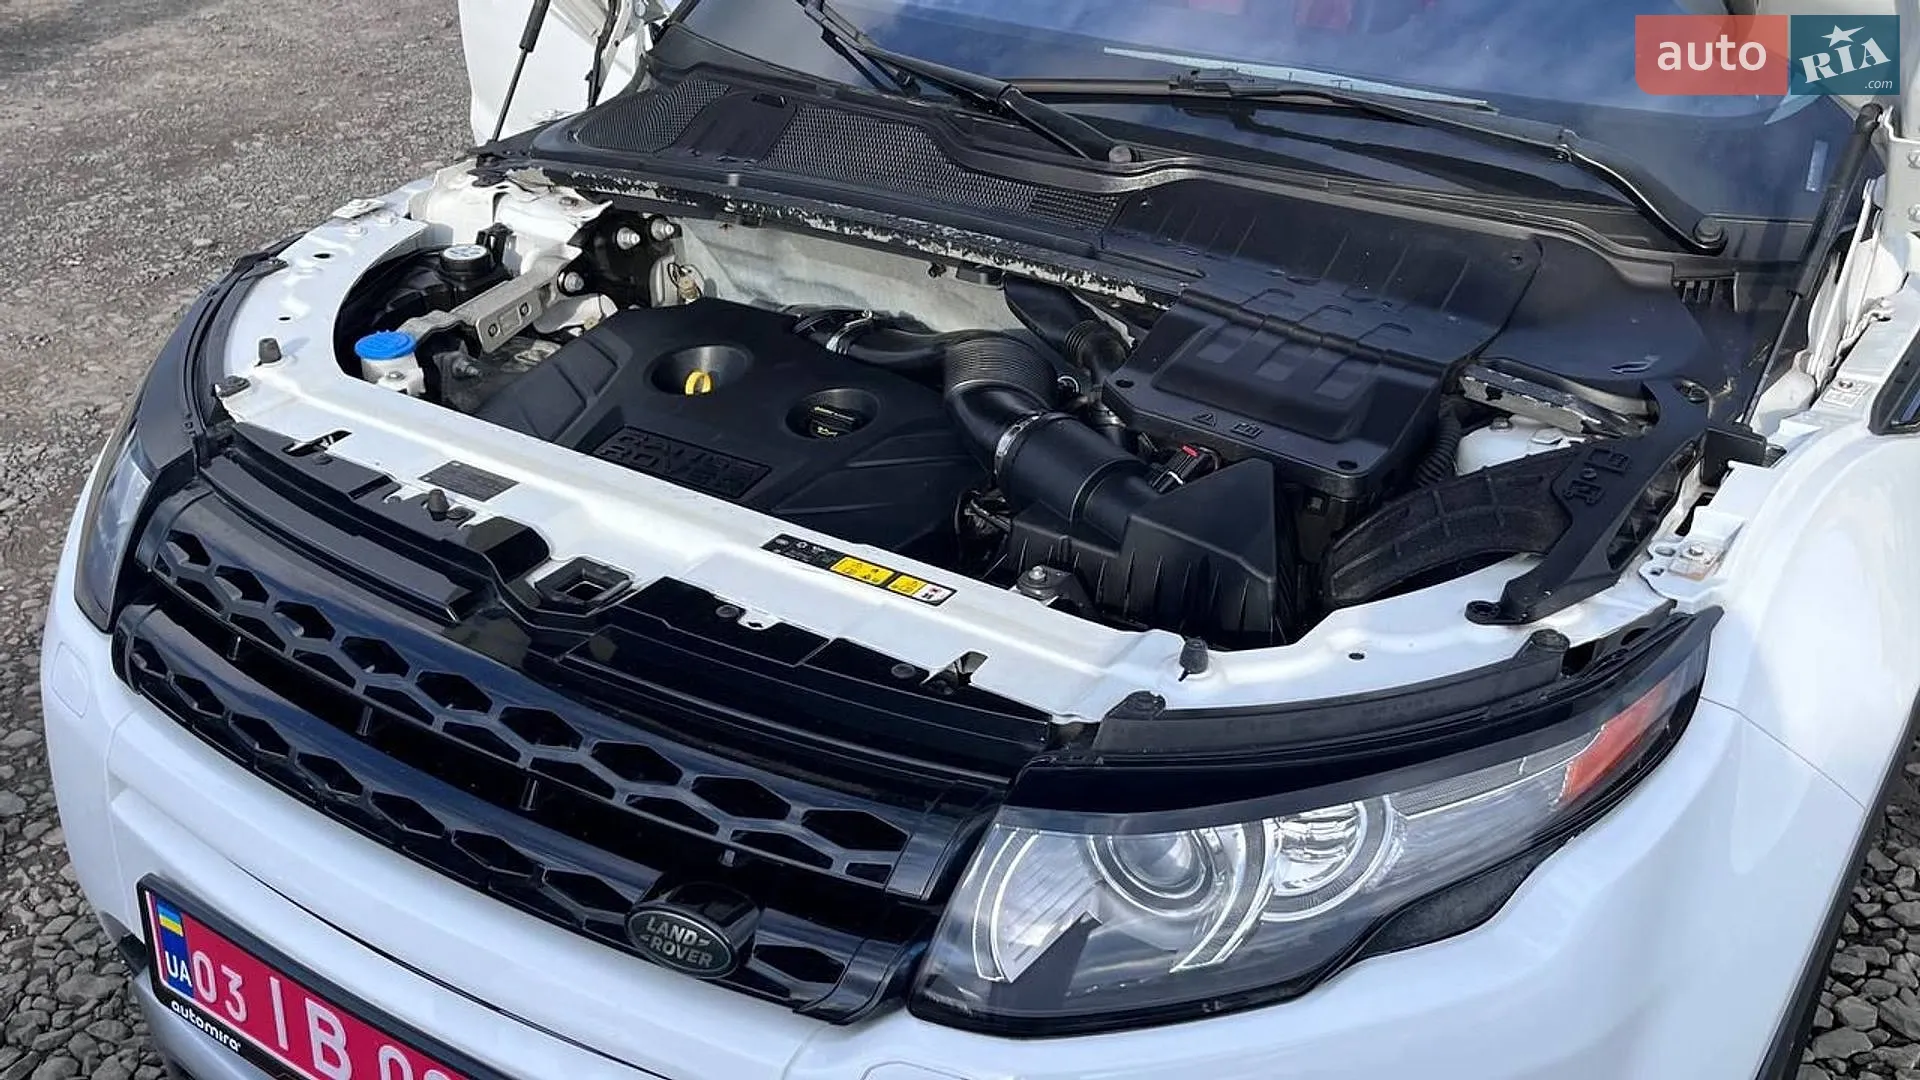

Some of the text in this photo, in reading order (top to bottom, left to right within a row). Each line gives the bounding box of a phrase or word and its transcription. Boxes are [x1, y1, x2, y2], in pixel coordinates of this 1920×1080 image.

[646, 916, 698, 946] LAND
[165, 950, 192, 987] UA
[649, 935, 713, 968] ROVER
[192, 950, 247, 1022] 03
[170, 1000, 241, 1052] automira
